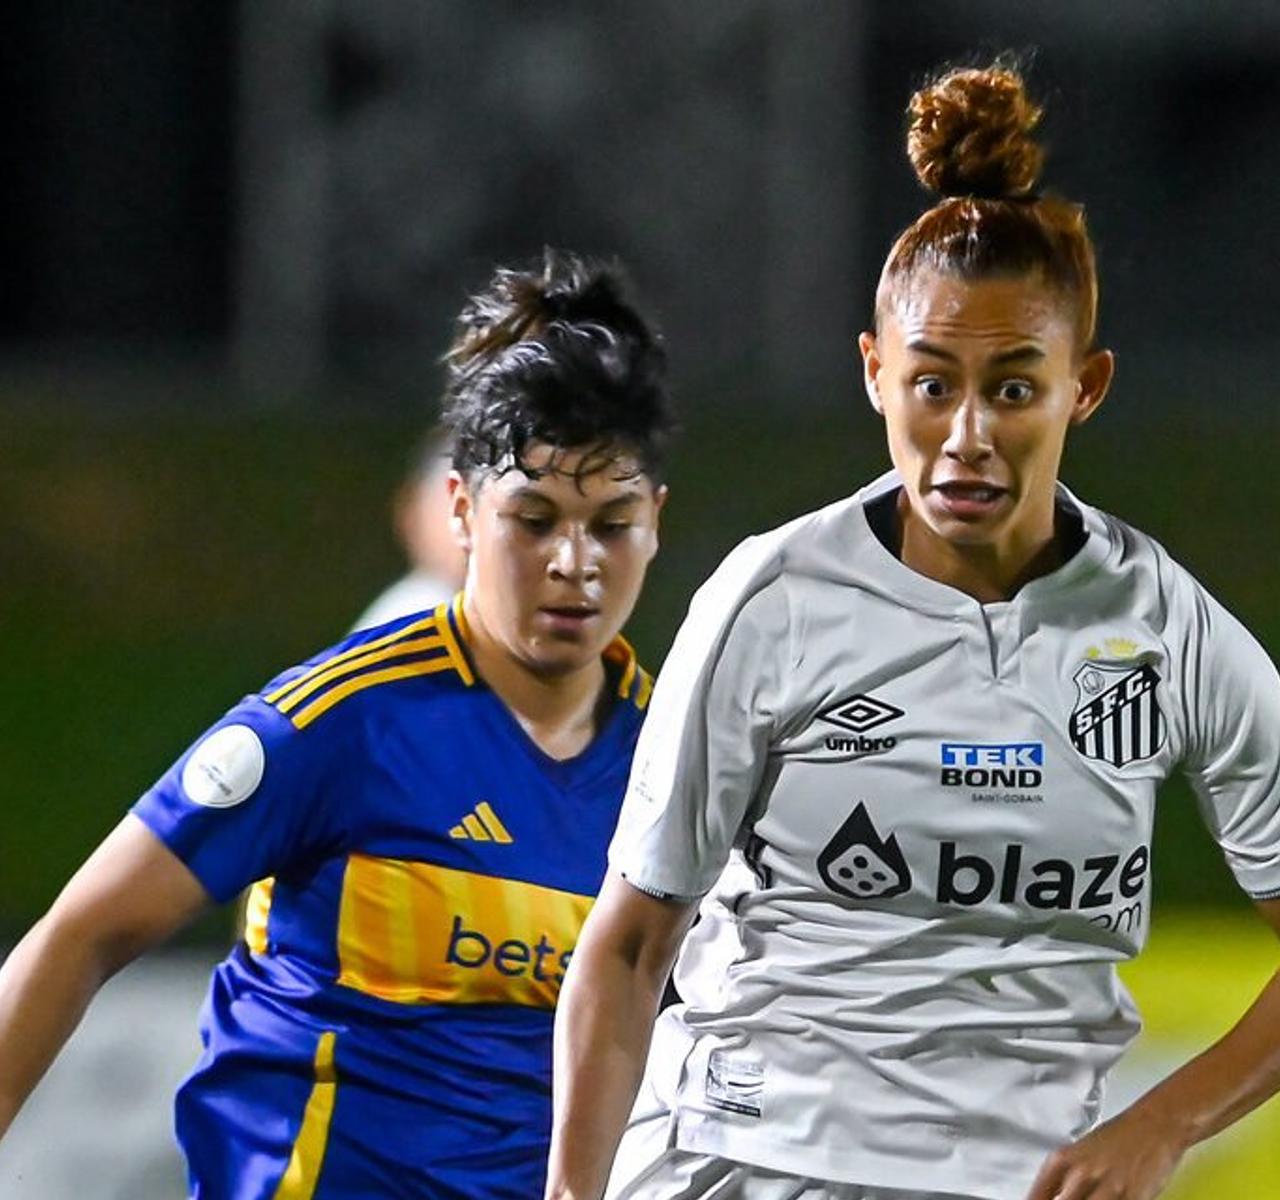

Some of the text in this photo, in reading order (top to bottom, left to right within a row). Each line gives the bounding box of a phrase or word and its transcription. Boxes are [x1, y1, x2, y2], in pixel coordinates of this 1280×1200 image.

[824, 736, 897, 752] umbro
[943, 745, 1038, 766] TEK
[940, 768, 1042, 788] BOND
[936, 841, 1149, 909] blaze
